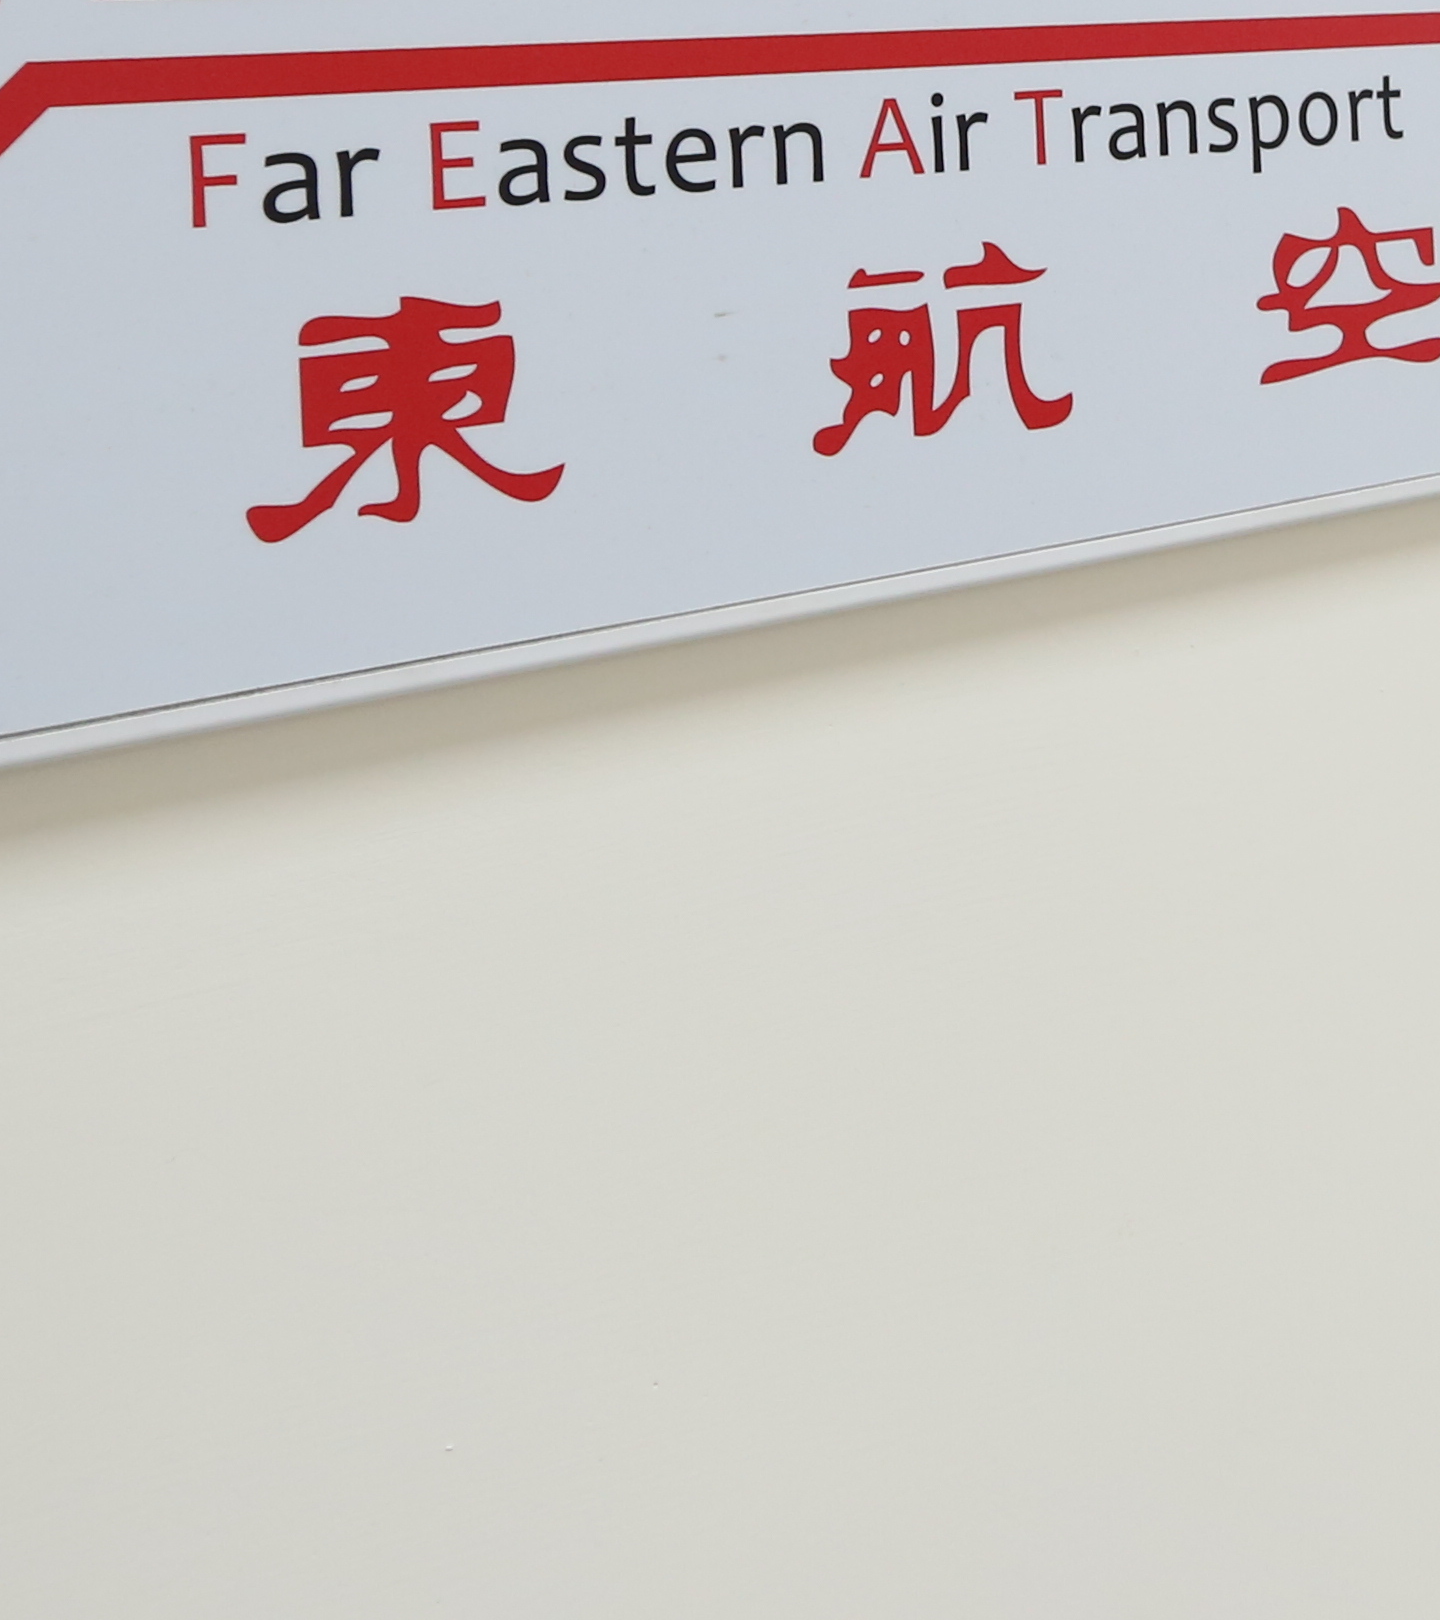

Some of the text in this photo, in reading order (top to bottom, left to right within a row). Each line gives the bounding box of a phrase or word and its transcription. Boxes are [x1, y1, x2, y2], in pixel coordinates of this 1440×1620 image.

[188, 74, 1405, 229] Far Eastern Air Transport
